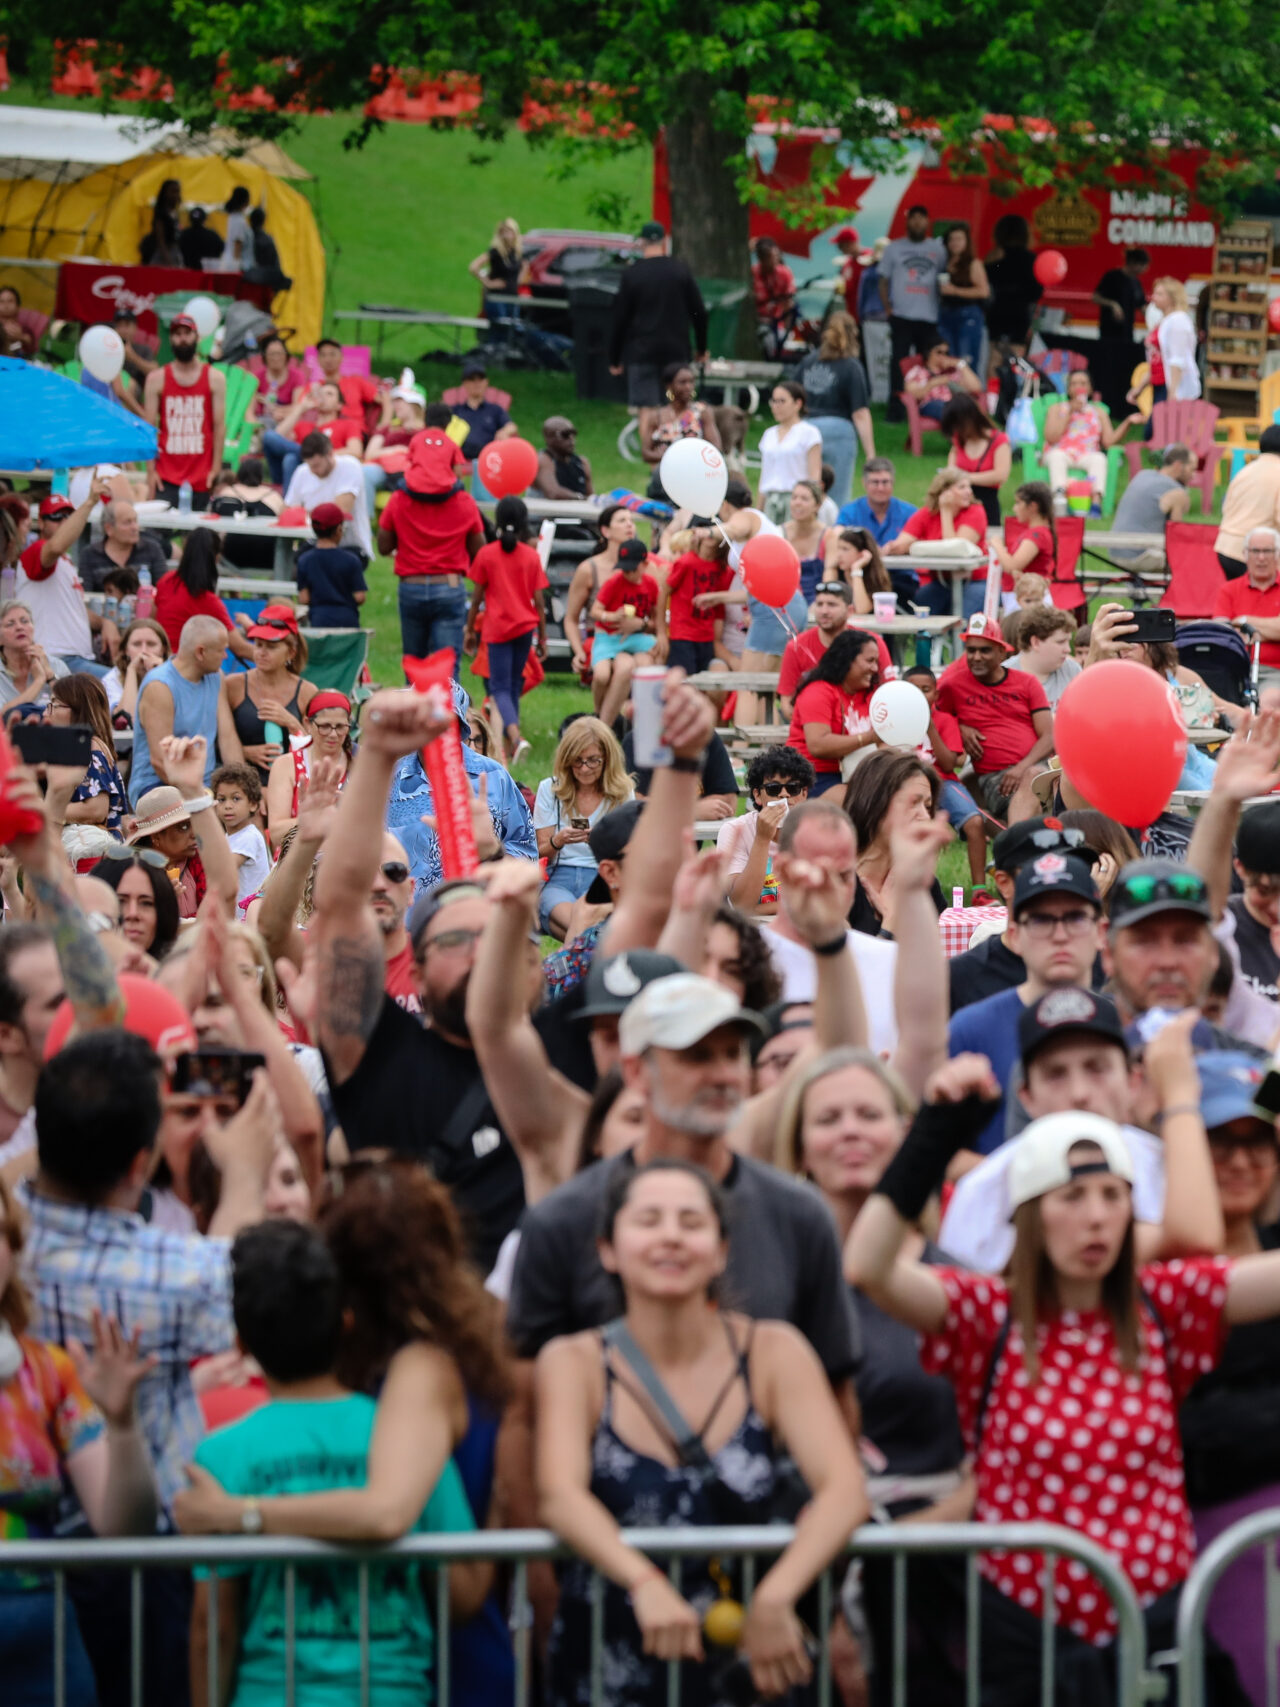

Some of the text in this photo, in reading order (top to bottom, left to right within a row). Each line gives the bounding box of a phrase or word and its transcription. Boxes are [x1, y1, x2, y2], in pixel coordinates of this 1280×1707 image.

[1107, 218, 1215, 248] COMMAND
[165, 395, 206, 416] PARK
[167, 417, 204, 434] WAY
